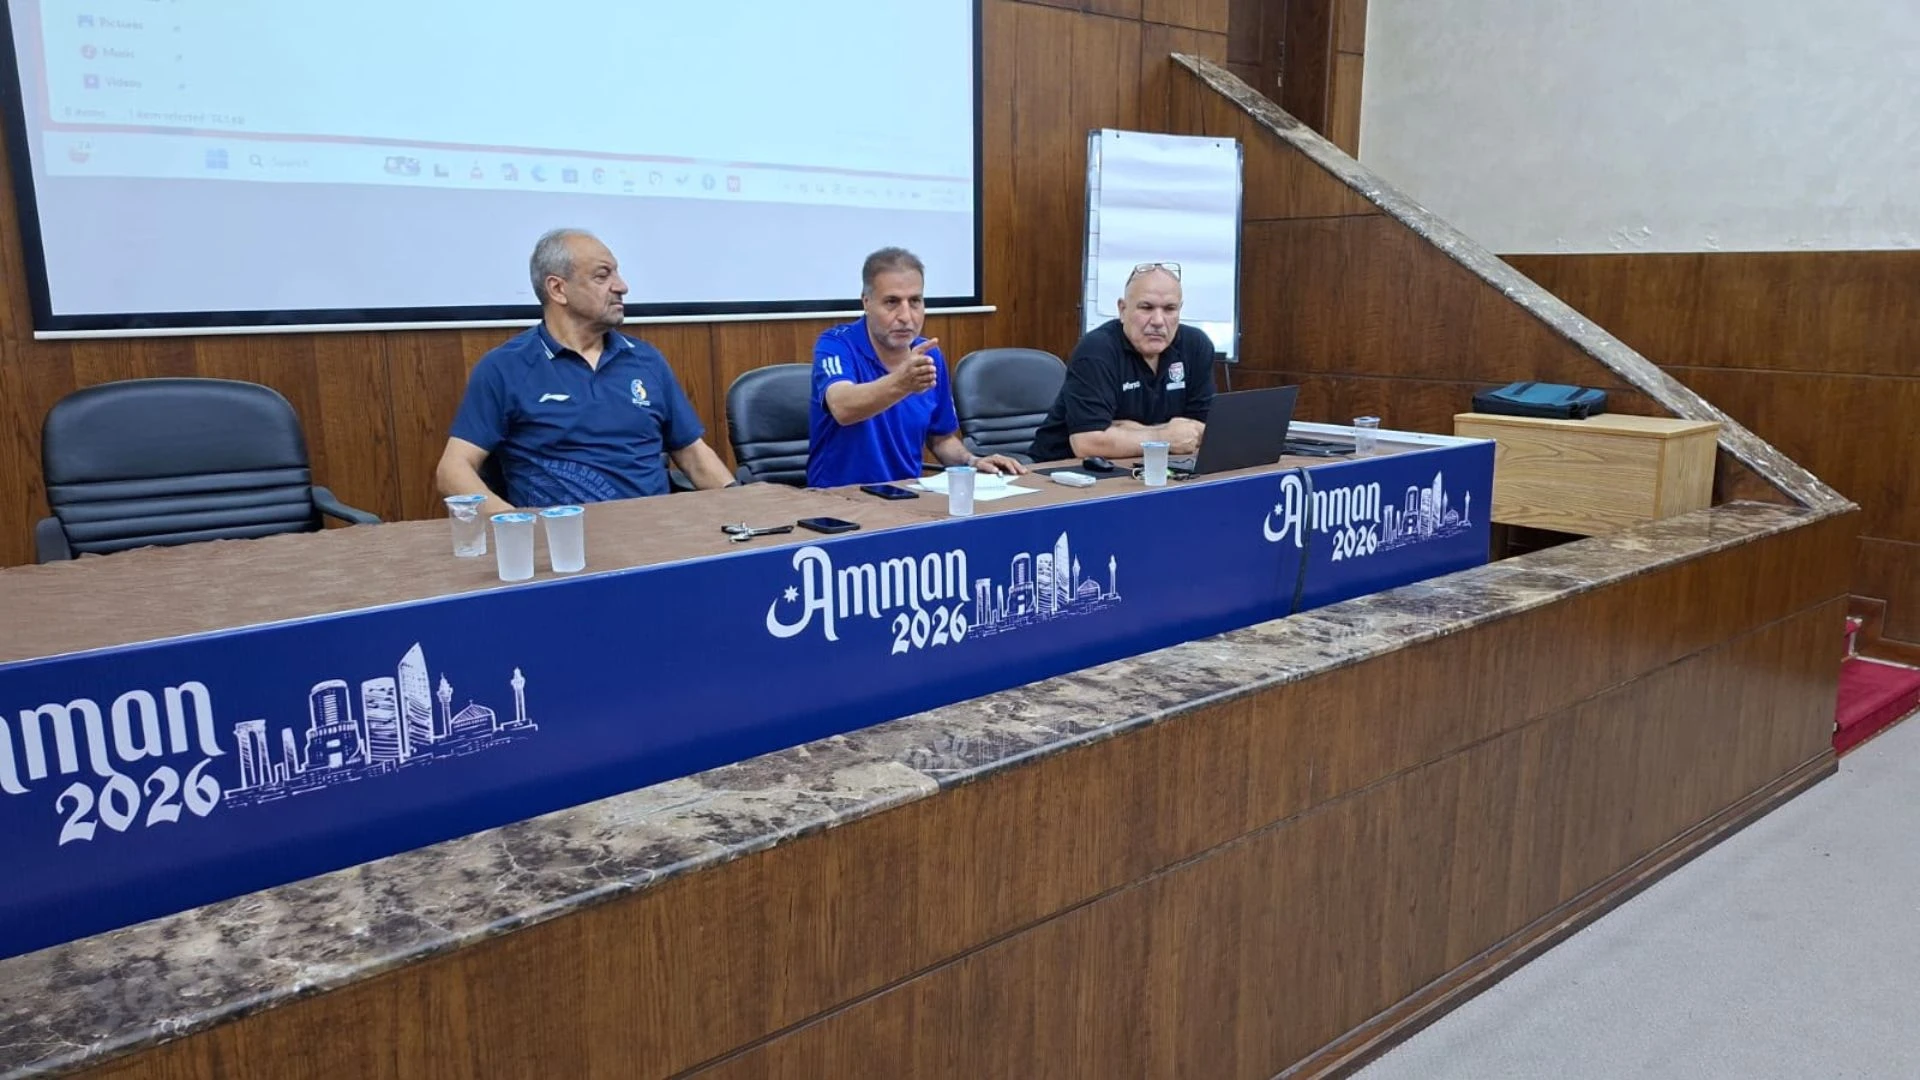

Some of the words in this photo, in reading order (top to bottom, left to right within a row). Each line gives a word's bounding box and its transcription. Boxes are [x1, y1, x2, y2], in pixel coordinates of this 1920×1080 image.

[98, 17, 144, 30] Pictures
[102, 47, 135, 59] Music
[105, 75, 142, 89] Videos
[1263, 474, 1381, 548] Amman
[1331, 523, 1378, 561] 2026
[766, 546, 971, 641] Amman
[891, 602, 967, 655] 2026
[0, 681, 227, 795] man
[55, 757, 221, 846] 2026
